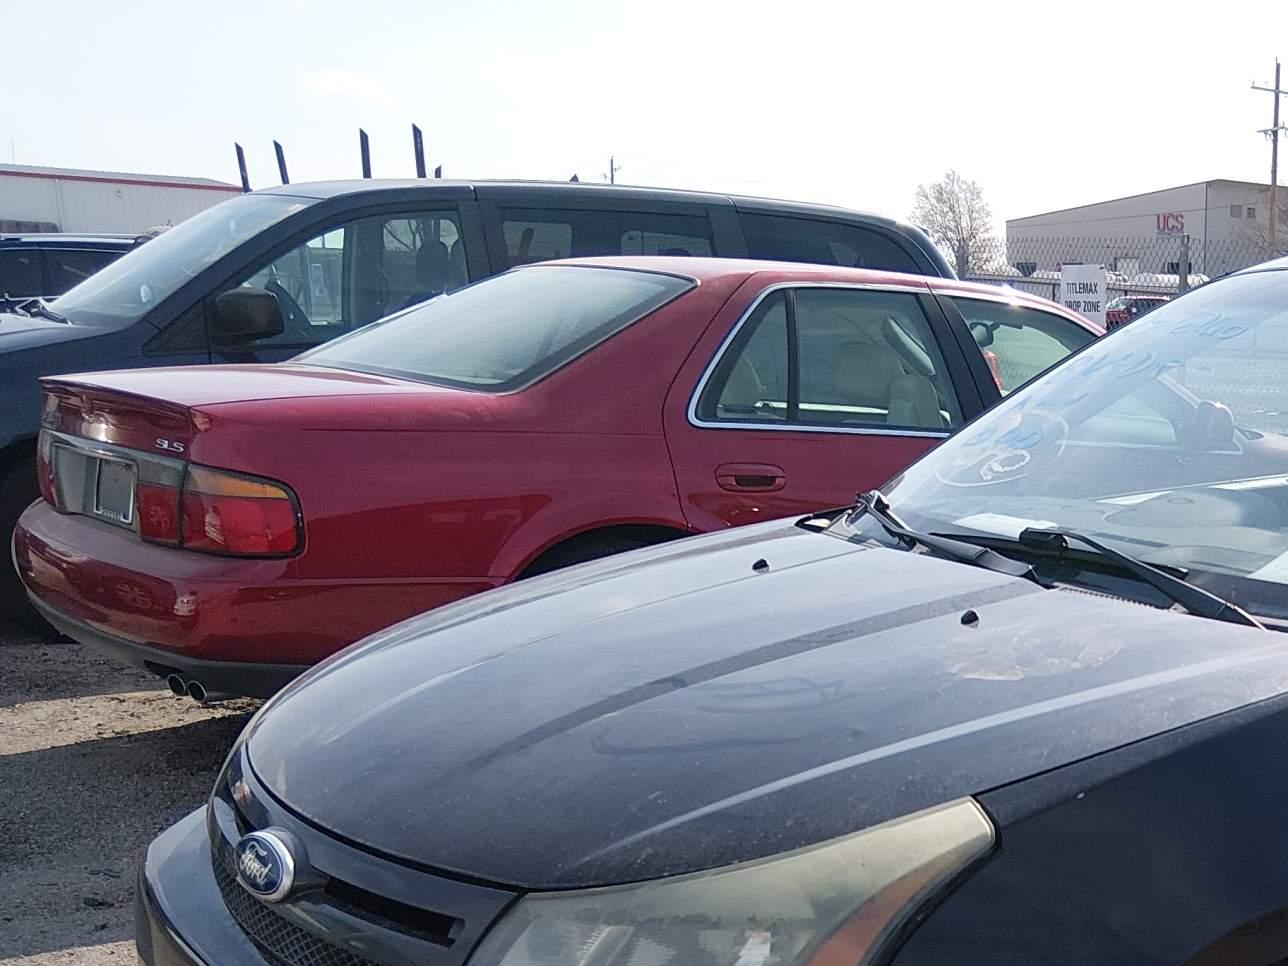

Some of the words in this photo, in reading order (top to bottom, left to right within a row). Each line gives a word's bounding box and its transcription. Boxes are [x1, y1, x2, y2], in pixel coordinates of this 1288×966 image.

[1157, 213, 1184, 232] UCS
[1066, 283, 1098, 294] TITLEMAX
[1065, 301, 1081, 312] DROP
[1083, 301, 1101, 312] ZONE
[155, 438, 185, 453] SLS
[240, 841, 272, 884] Ford
